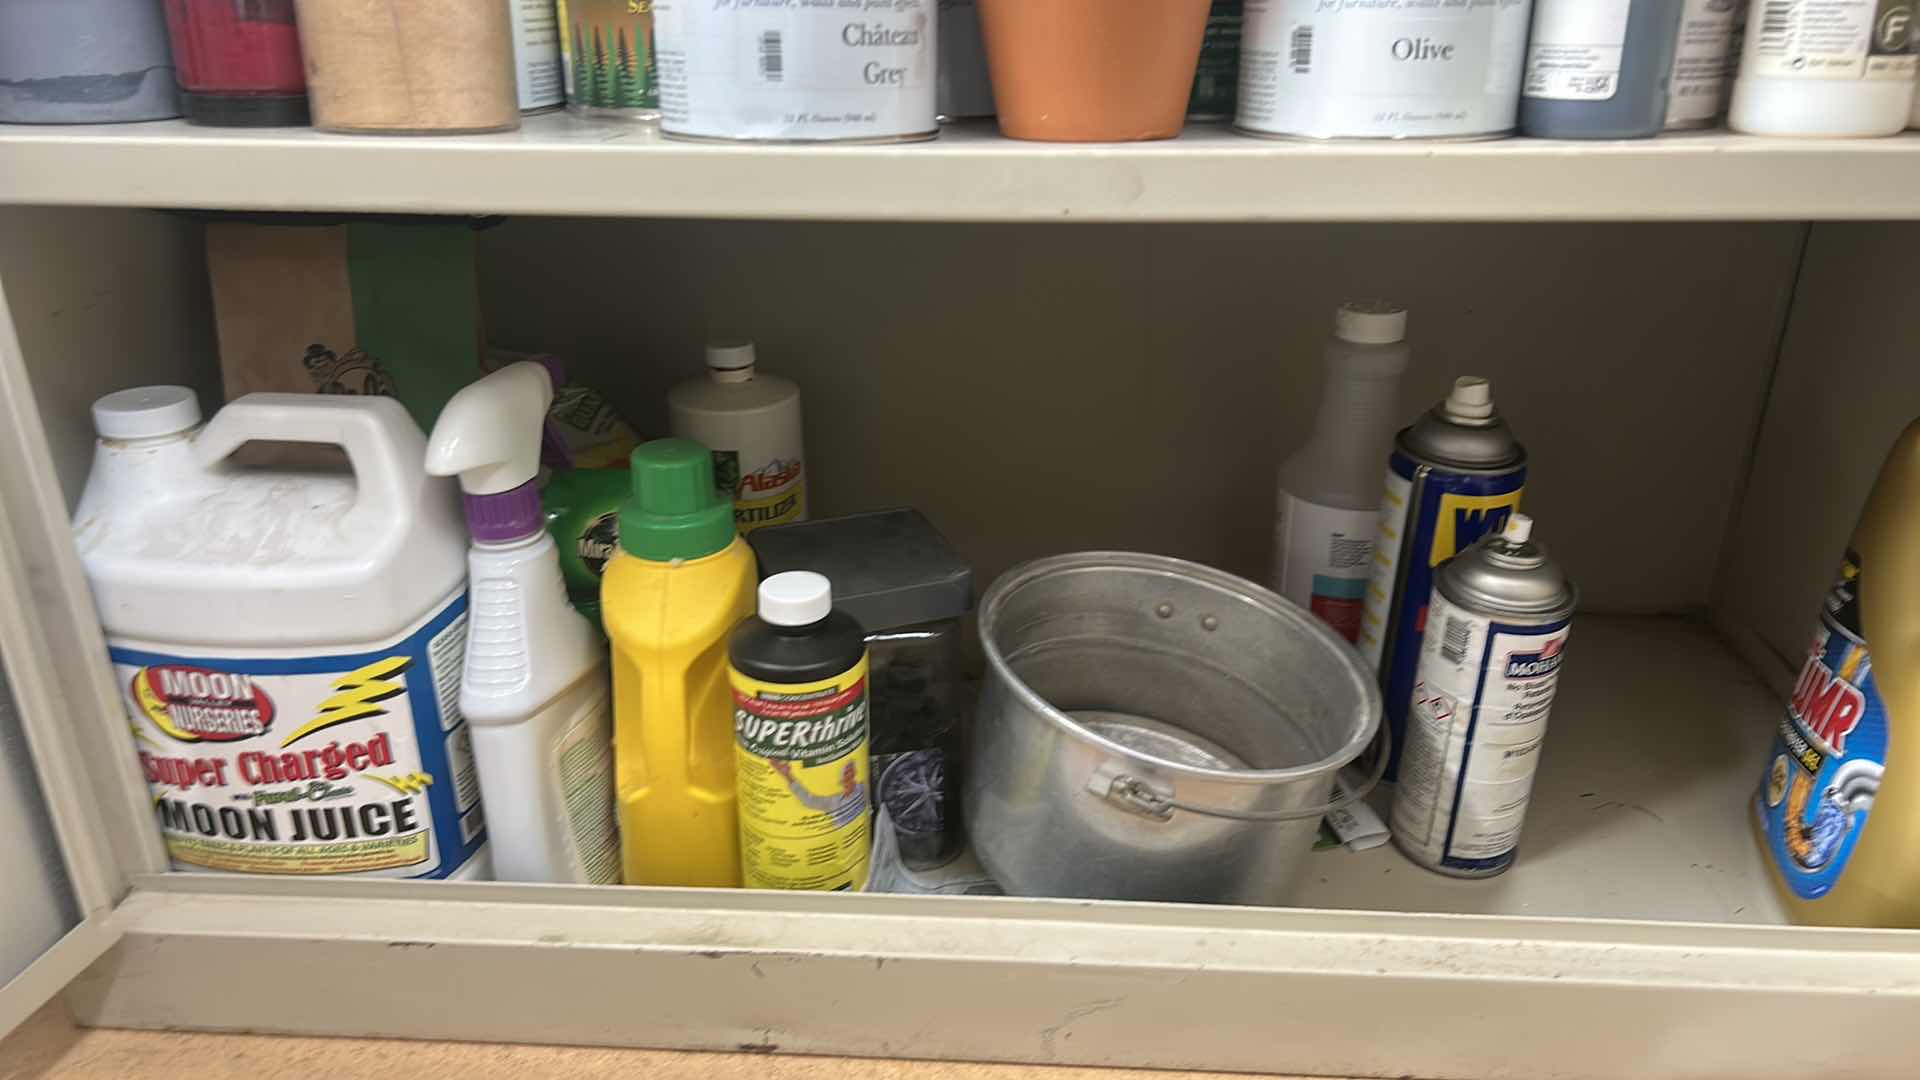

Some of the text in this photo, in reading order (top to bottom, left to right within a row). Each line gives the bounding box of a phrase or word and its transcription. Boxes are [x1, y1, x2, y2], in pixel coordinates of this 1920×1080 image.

[1392, 37, 1455, 61] Olive
[863, 61, 907, 88] Grey
[161, 669, 255, 700] MOON
[168, 704, 263, 735] NURSERIES
[238, 732, 394, 782] Charged
[160, 796, 416, 840] MOON JUICE
